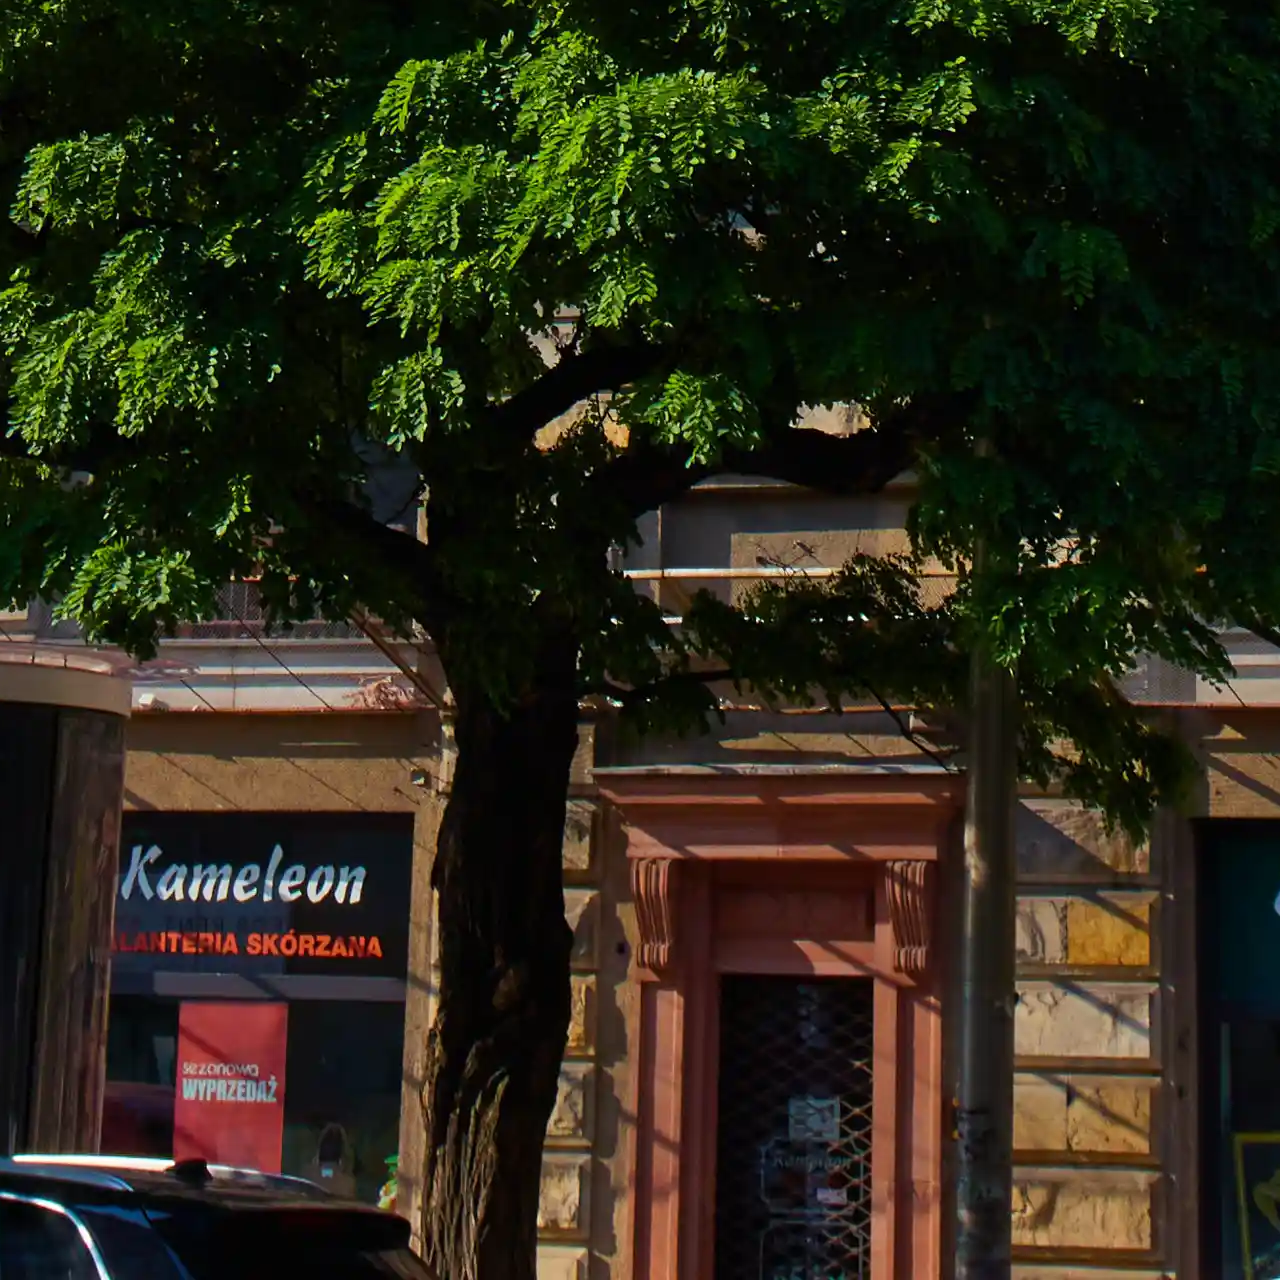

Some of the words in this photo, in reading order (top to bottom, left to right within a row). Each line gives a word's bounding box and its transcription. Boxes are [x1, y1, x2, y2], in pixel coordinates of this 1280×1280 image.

[120, 842, 368, 905] Kameleon
[246, 928, 384, 959] SKÓRZANA
[182, 1061, 260, 1077] sezonowa
[182, 1074, 278, 1103] WYPRZEDAŻ
